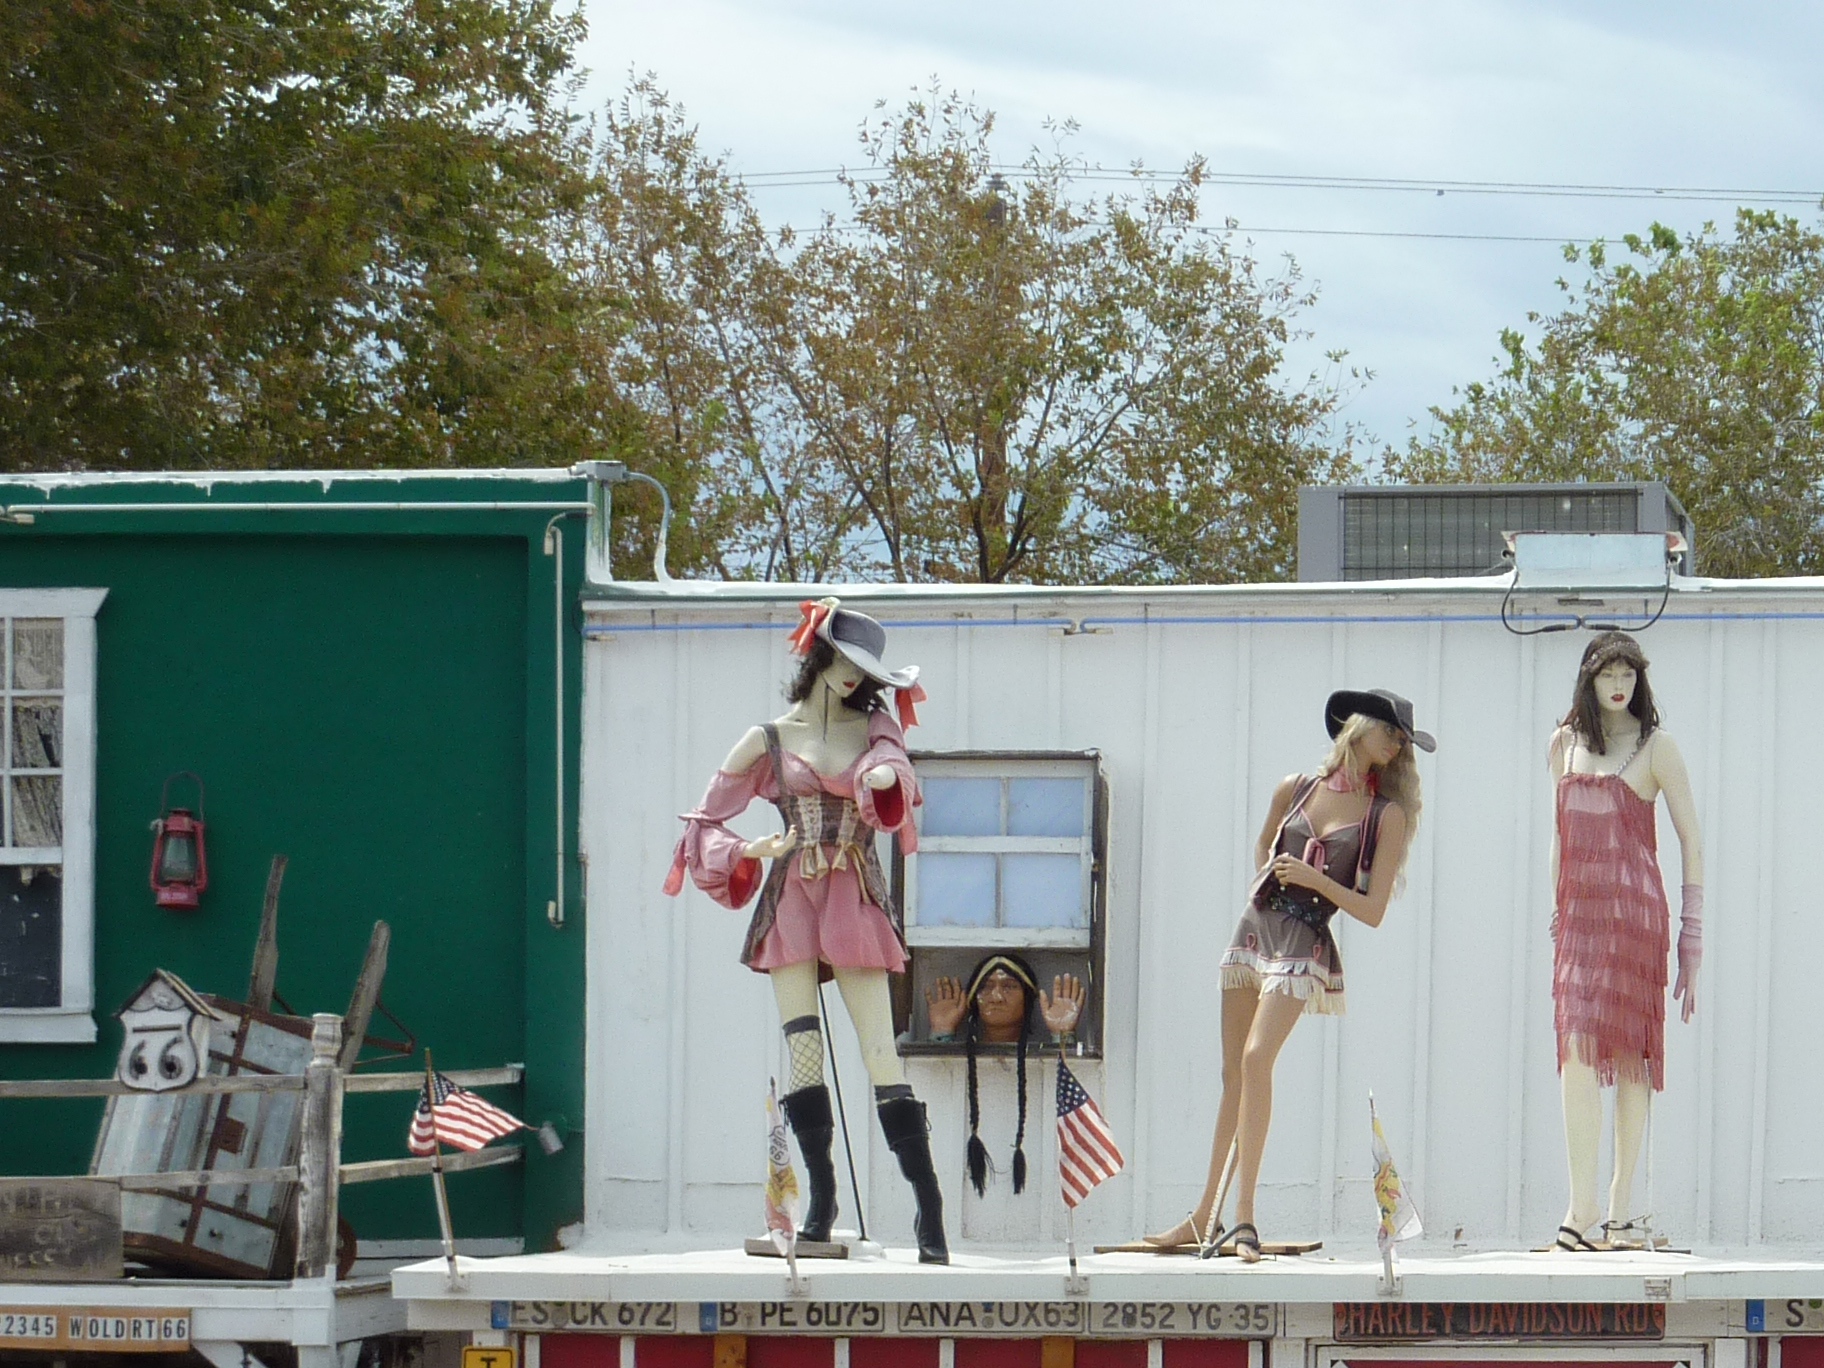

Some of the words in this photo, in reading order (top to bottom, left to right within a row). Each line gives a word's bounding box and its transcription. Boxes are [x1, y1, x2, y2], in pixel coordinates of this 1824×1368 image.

[129, 1036, 183, 1080] 66
[511, 1301, 550, 1326] ES
[569, 1301, 608, 1327] CK
[617, 1301, 672, 1327] 672
[719, 1301, 739, 1327] B
[761, 1301, 797, 1327] PE
[806, 1301, 880, 1327] 6075
[903, 1302, 977, 1327] ANA
[1102, 1302, 1175, 1330] 2852
[1187, 1303, 1222, 1331] YG
[1233, 1304, 1270, 1332] 35
[1349, 1303, 1451, 1334] HARLEY
[1468, 1303, 1602, 1333] DAVIDSON
[1613, 1303, 1654, 1333] RD
[1785, 1299, 1805, 1328] S
[161, 1318, 187, 1341] 66
